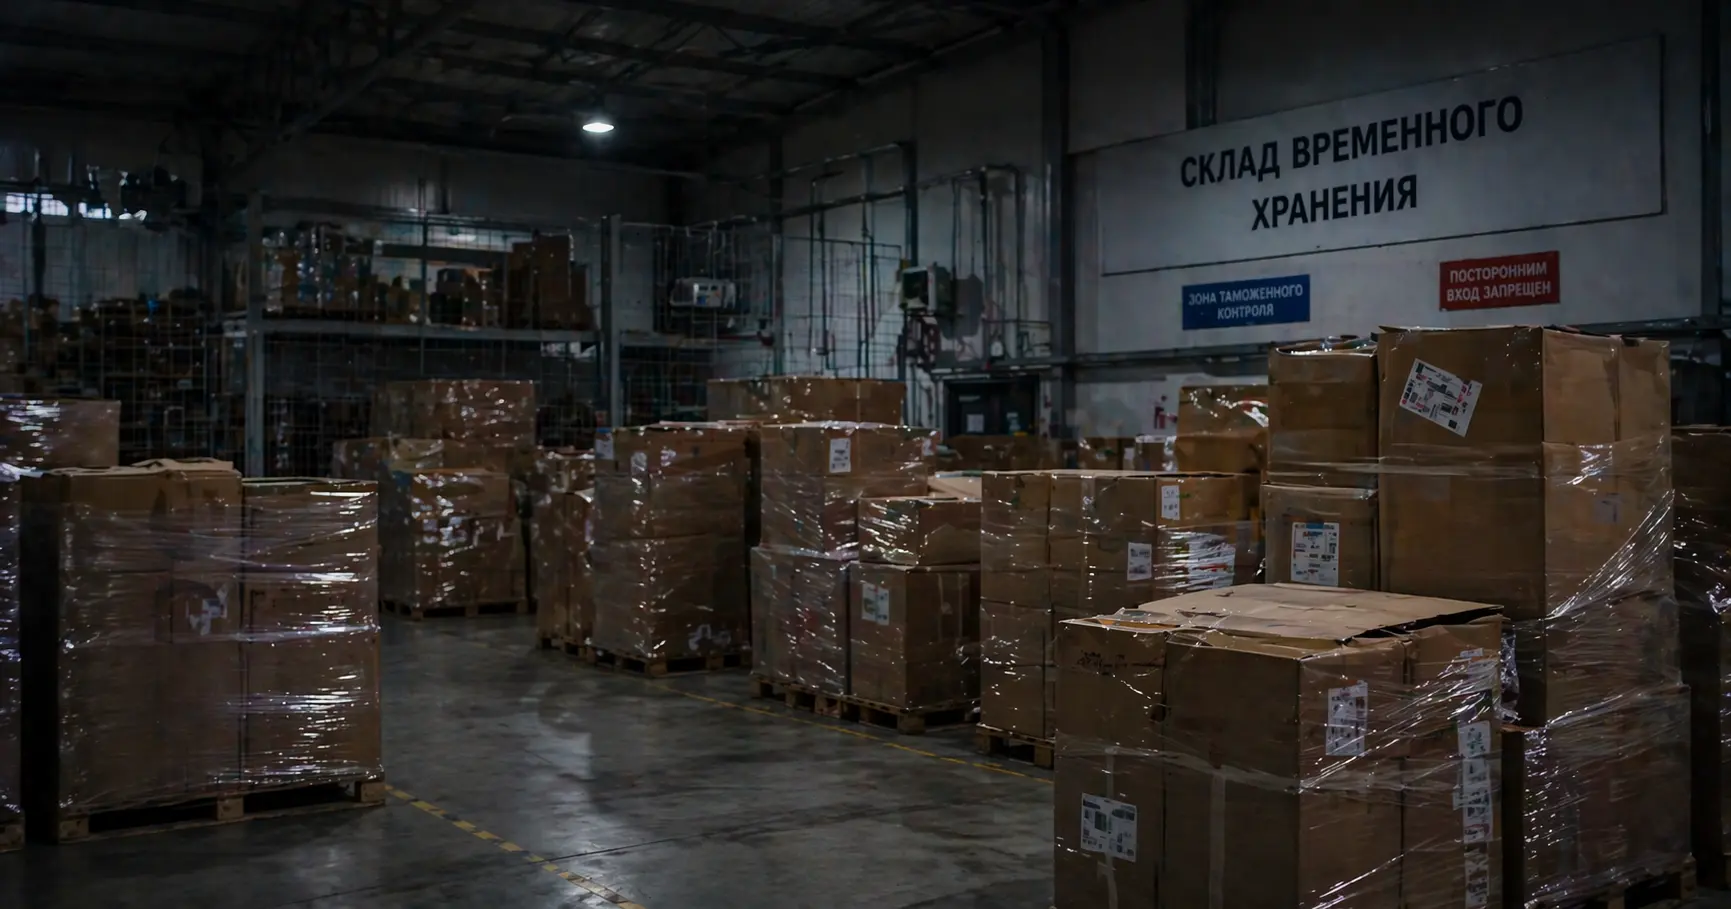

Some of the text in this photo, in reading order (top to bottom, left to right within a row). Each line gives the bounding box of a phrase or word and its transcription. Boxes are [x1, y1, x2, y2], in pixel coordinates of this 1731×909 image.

[1181, 95, 1523, 187] СКЛАД ВРЕМЕННОГО
[1251, 174, 1417, 231] ХРАНЕНИЯ
[1449, 261, 1547, 284] ПОСТОРОННИМ
[1187, 283, 1304, 306] ЗОНА ТАМОЖЕННОГО
[1446, 280, 1552, 303] ВХОД ЗАПРЕЩЕН
[1216, 303, 1275, 320] КОНТРОЛЯ
